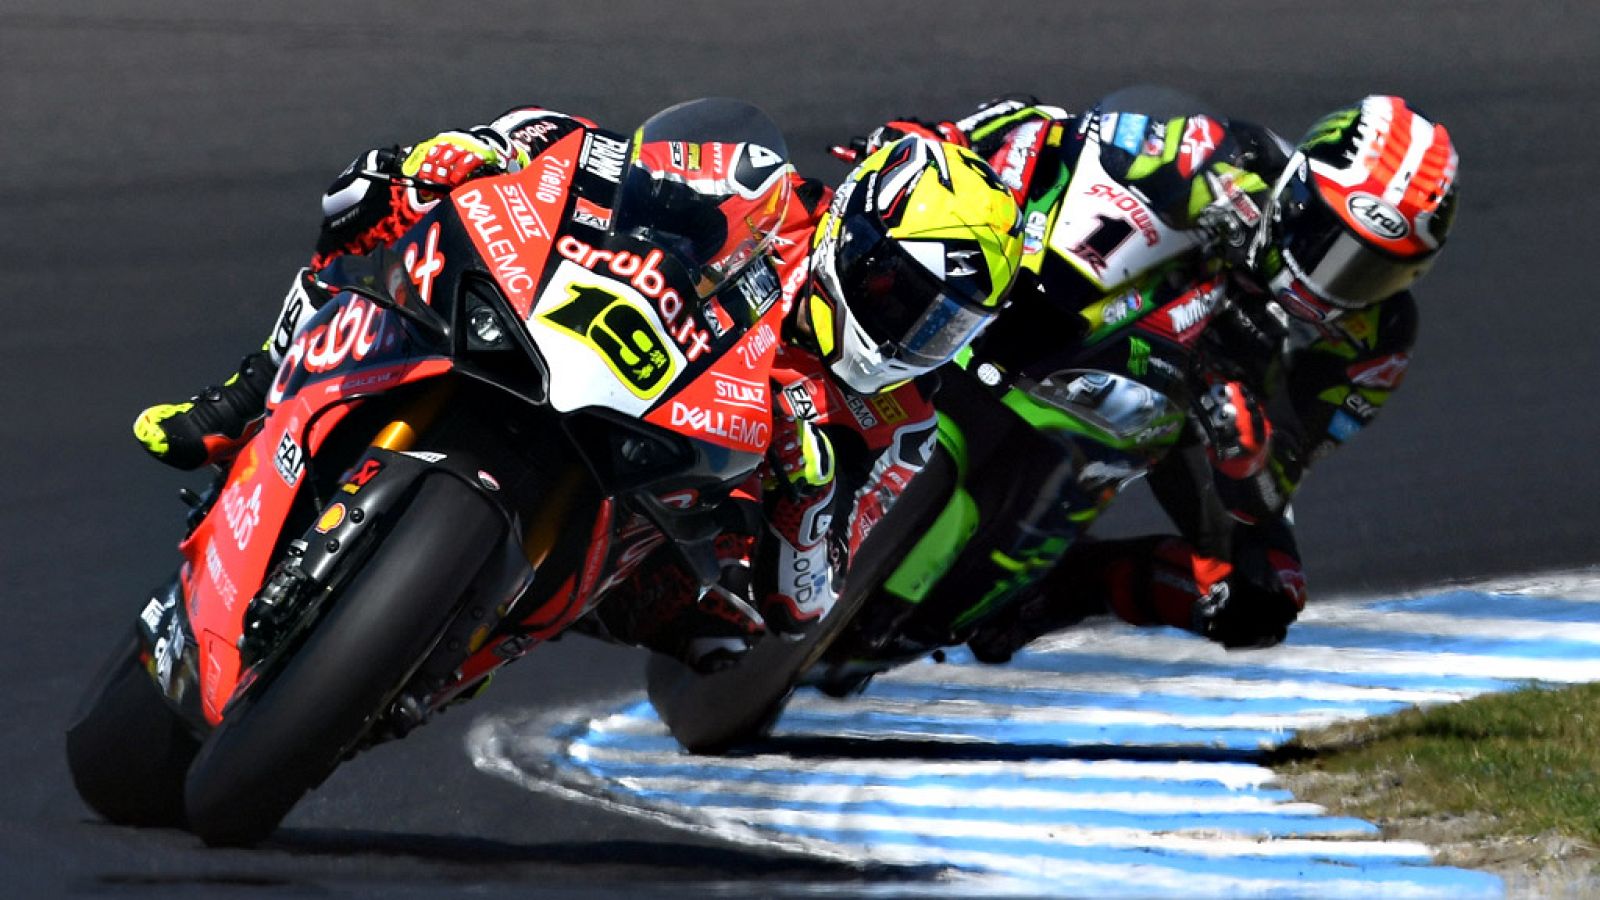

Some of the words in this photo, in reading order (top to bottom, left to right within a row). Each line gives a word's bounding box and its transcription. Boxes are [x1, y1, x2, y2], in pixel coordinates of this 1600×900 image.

[1083, 183, 1160, 247] SHOWA
[1083, 213, 1137, 262] 1
[1352, 203, 1405, 233] Arai
[534, 280, 677, 401] 19
